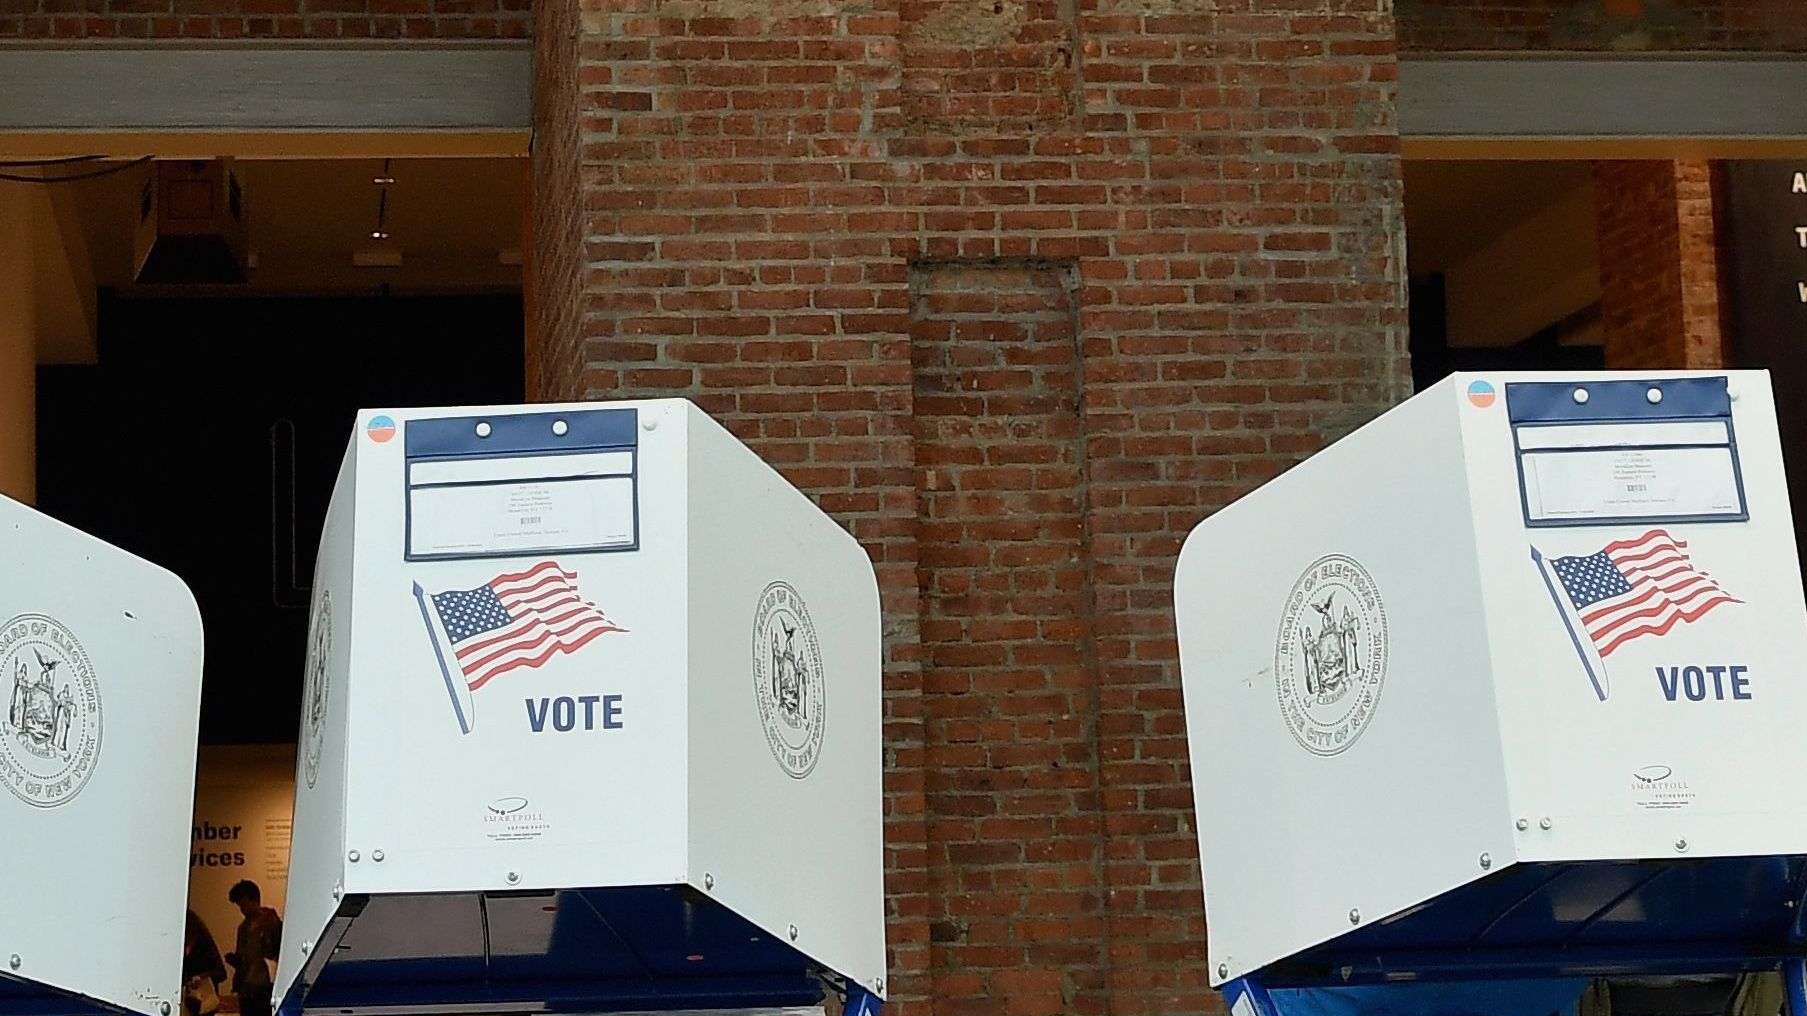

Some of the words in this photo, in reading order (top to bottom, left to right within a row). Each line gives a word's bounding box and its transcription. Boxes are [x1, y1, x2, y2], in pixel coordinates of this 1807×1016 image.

[31, 622, 47, 636] OF
[1656, 666, 1752, 701] VOTE
[525, 695, 623, 732] VOTE
[1306, 727, 1332, 746] CITY
[1334, 723, 1349, 744] OF
[26, 782, 42, 796] OF
[45, 775, 72, 798] NEW
